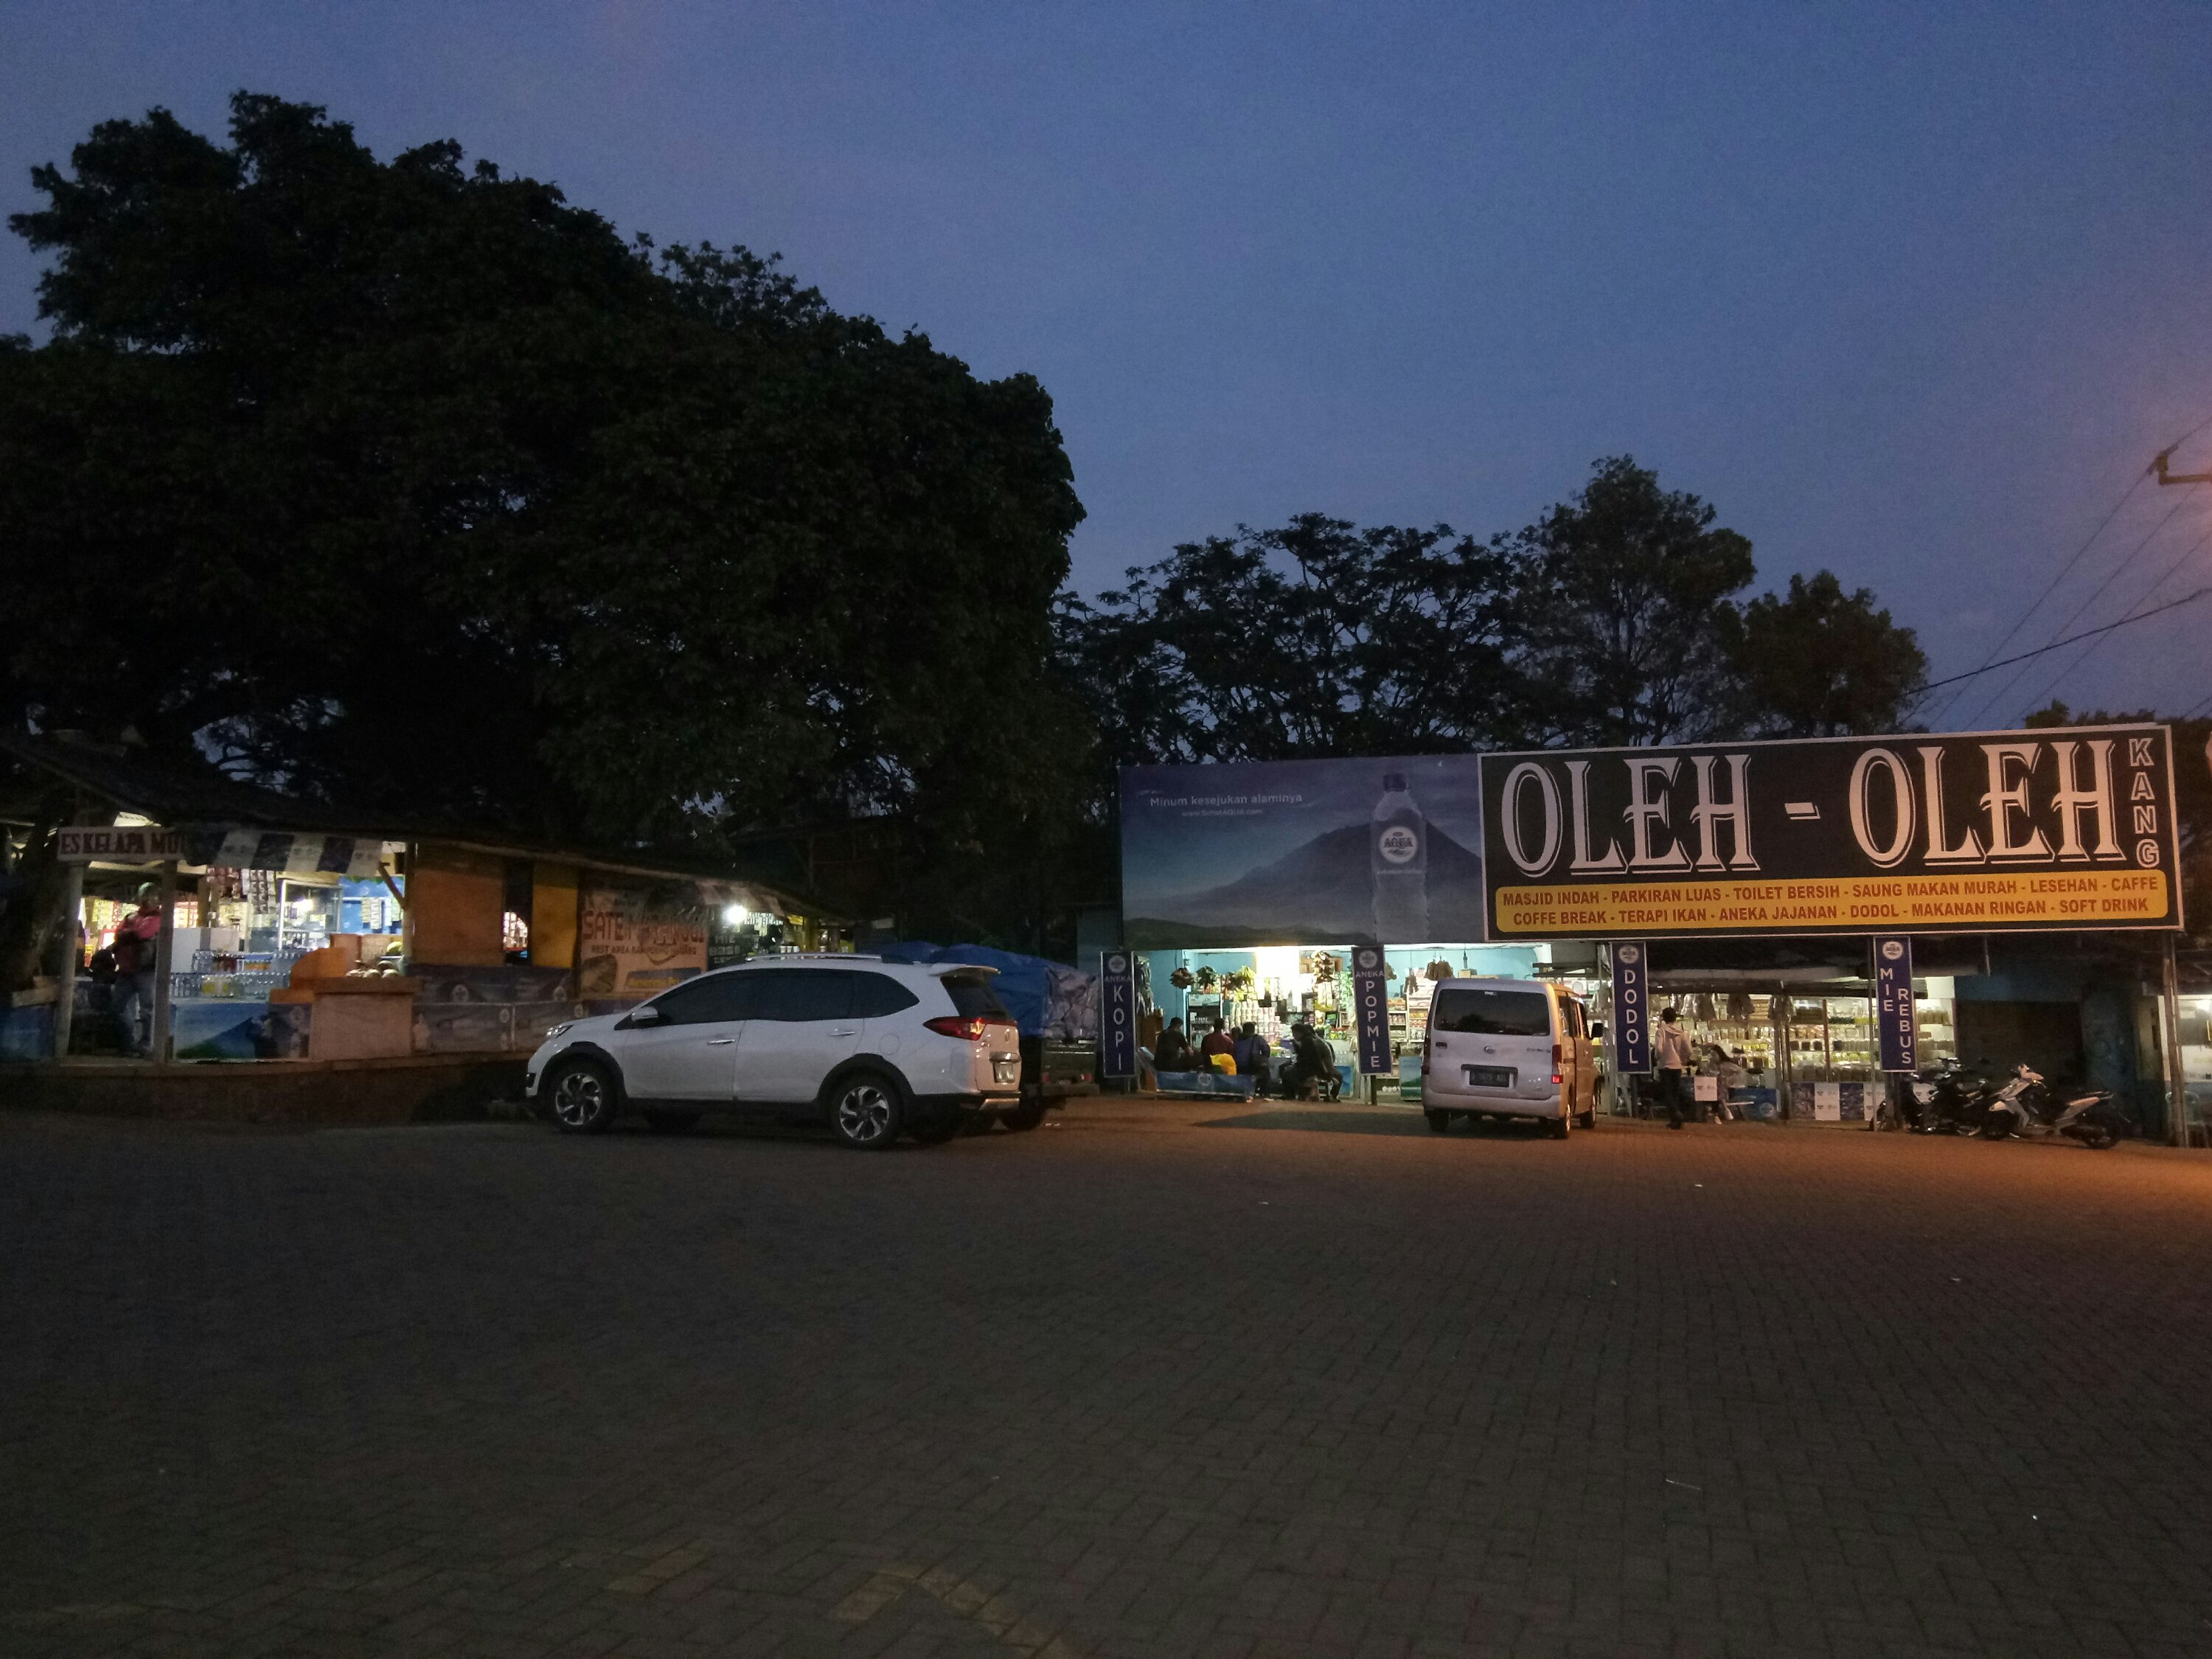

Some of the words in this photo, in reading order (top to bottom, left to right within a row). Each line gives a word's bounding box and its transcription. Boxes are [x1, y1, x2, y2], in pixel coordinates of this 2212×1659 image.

[1150, 796, 1188, 807] Minum
[1191, 795, 1248, 807] kesejukan
[1251, 793, 1303, 805] alaminya
[1501, 754, 1761, 878] OLEH
[1784, 801, 1821, 821] -
[1848, 739, 2126, 869] OLEH
[2128, 737, 2161, 869] KANG
[60, 834, 80, 854] ES
[83, 832, 147, 854] KELAPA
[1383, 836, 1413, 849] AQUA
[1503, 891, 1554, 906] MASJID
[1557, 890, 1600, 905] INDAH
[1611, 888, 1682, 904] PARKIRAN
[1685, 887, 1722, 902] LUAS
[1733, 886, 1783, 901] TOILET
[1787, 884, 1840, 900] BERSIH
[1852, 883, 1903, 899] SAUNG
[1907, 881, 1959, 897] MAKAN
[1964, 880, 2017, 896] MURAH
[2030, 877, 2098, 894] LESEHAN
[2111, 875, 2159, 891] CAFFE
[582, 911, 625, 941] SATE
[1513, 911, 1557, 926] COFFE
[1560, 910, 1607, 925] BREAK
[1618, 908, 1669, 924] TERAPI
[1672, 908, 1707, 922] IKAN
[1719, 906, 1769, 921] ANEKA
[1772, 904, 1837, 921] JAJANAN
[1850, 903, 1899, 919] DODOL
[1911, 901, 1985, 917] MAKANAN
[1989, 900, 2046, 916] RINGAN
[2059, 899, 2097, 914] SOFT
[2101, 897, 2149, 913] DRINK
[1104, 975, 1133, 983] ANEKA
[1354, 970, 1385, 978] ANEKA
[1879, 967, 1893, 1013] MIE
[1113, 984, 1125, 1071] KOPI
[1365, 980, 1380, 1068] POPMIE
[1624, 969, 1640, 1066] DODOL
[1896, 987, 1912, 1066] REBUS
